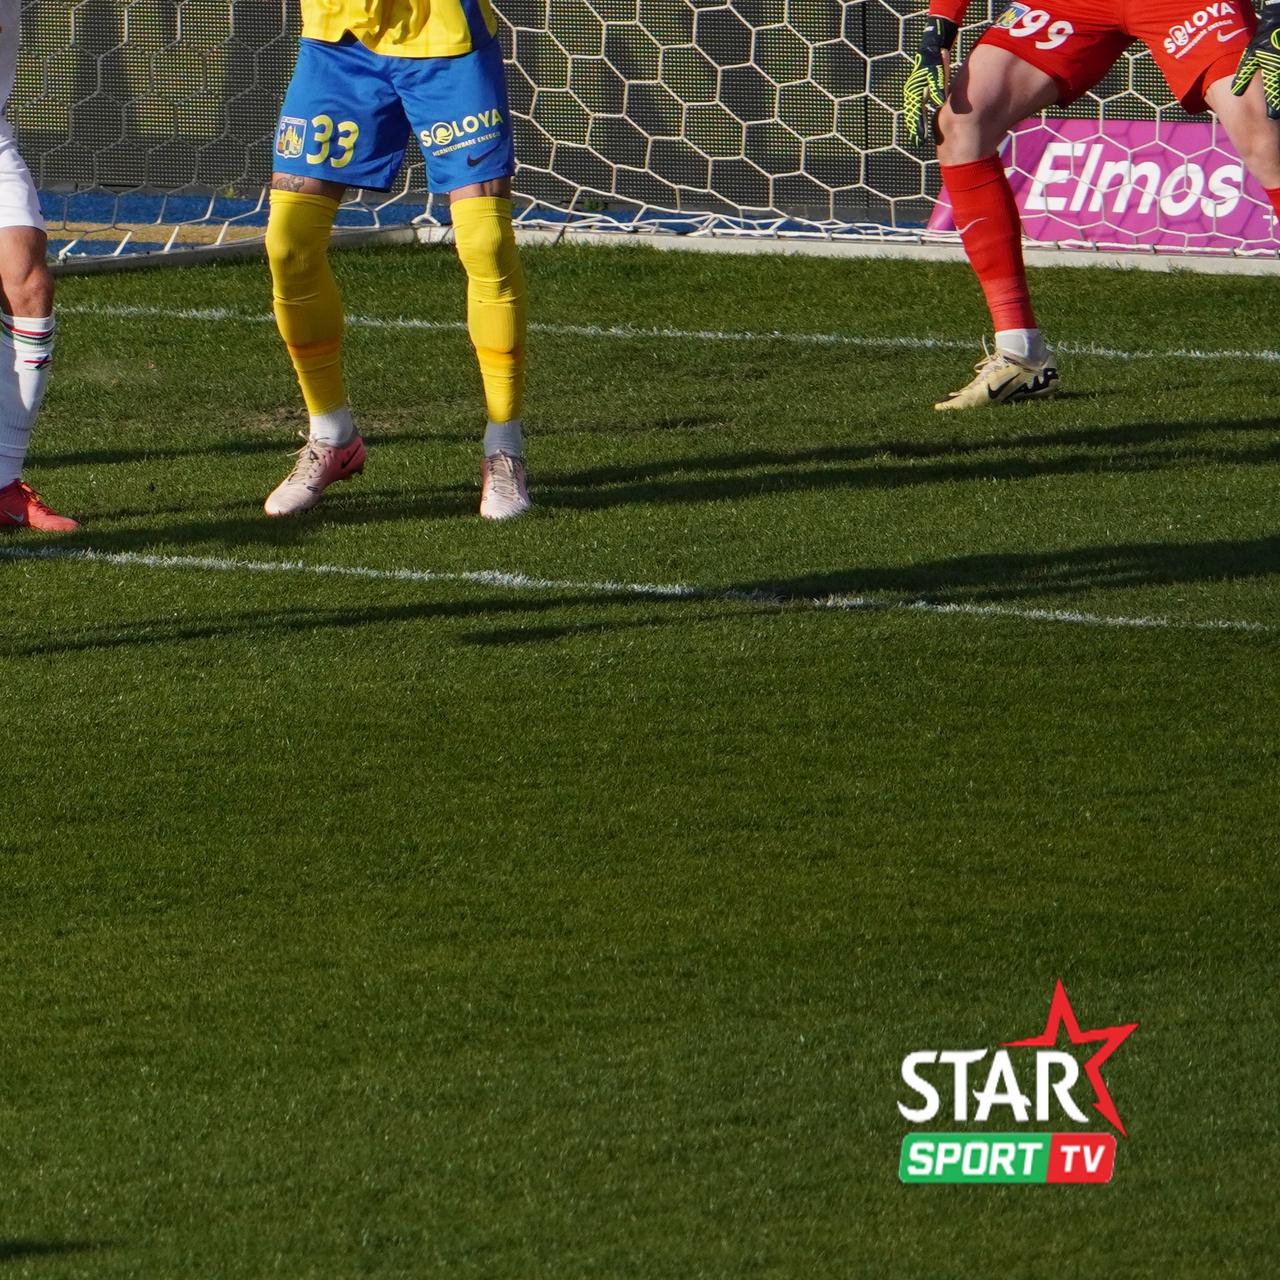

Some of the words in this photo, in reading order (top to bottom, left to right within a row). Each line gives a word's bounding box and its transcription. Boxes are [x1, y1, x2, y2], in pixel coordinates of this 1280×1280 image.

[1009, 9, 1074, 50] 99
[1162, 1, 1237, 54] SOLOYA
[306, 114, 359, 168] 33
[420, 108, 503, 148] SOLOYA
[1024, 140, 1241, 218] Elmos
